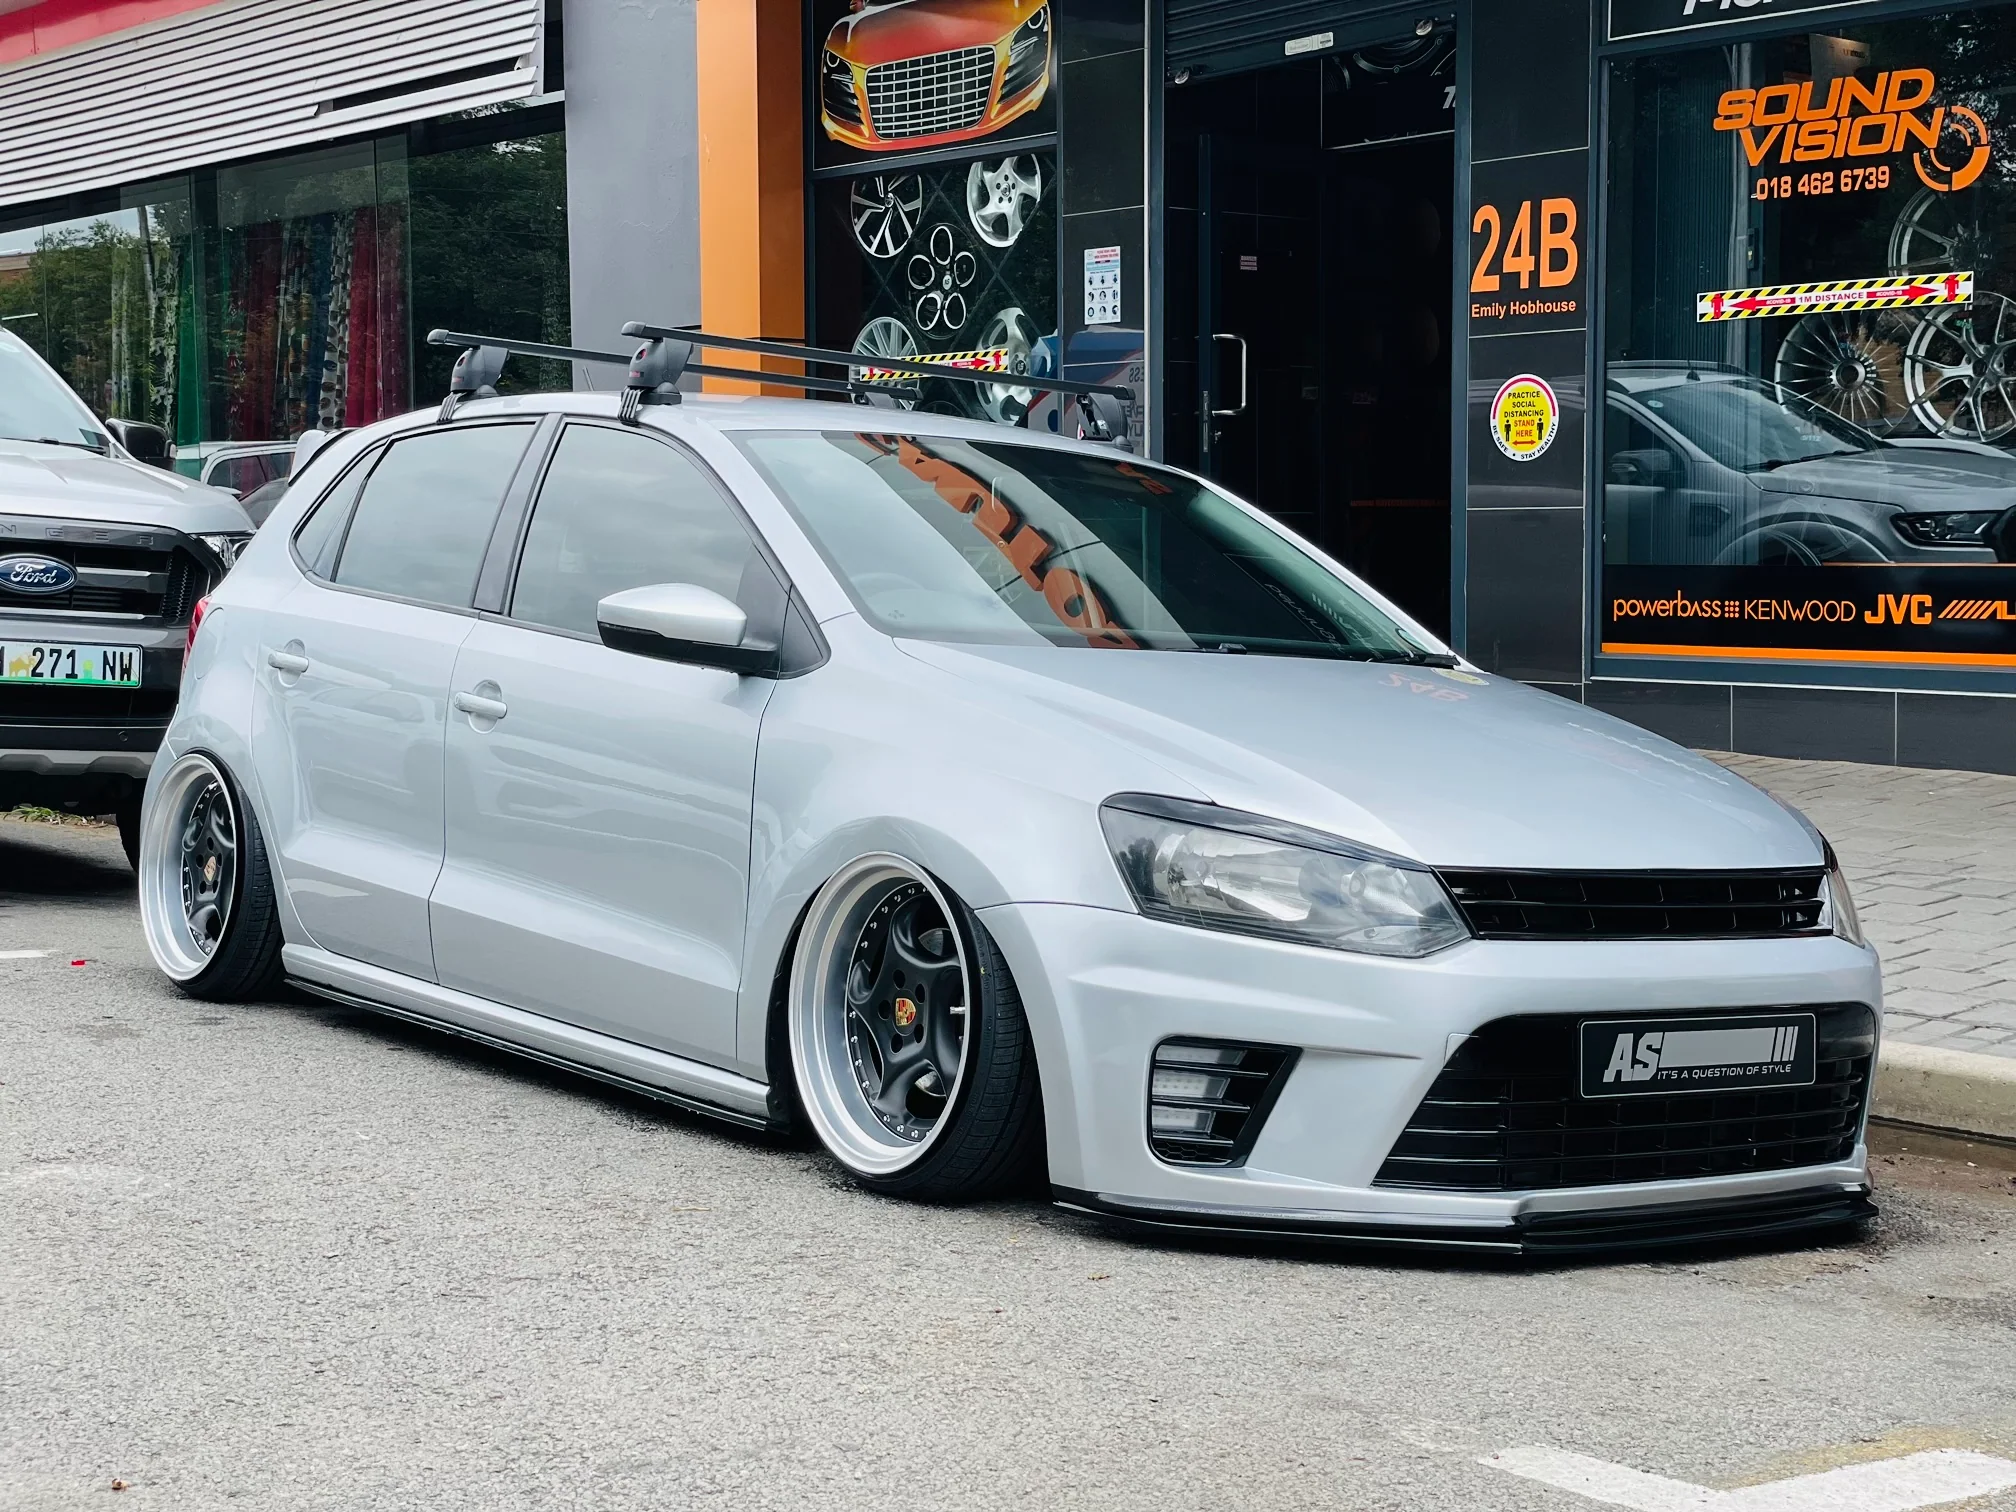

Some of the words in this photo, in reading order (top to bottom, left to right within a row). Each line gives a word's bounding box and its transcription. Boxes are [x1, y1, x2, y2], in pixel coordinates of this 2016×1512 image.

[1713, 68, 1935, 131] SOUND
[1739, 107, 1945, 167] VISION
[1756, 176, 1792, 200] 018
[1797, 171, 1834, 195] 462
[1840, 165, 1890, 192] 6739
[1470, 197, 1579, 293] 24B
[1471, 302, 1507, 320] Emily
[1510, 300, 1577, 315] Hobhouse
[1815, 292, 1865, 302] DISTANCE
[1508, 391, 1540, 399] PRACTICE
[1504, 410, 1544, 418] DISTANCING
[1514, 419, 1535, 427] STAND
[1492, 425, 1499, 434] BE
[1496, 436, 1508, 453] SAFE
[1515, 429, 1533, 437] HERE
[1520, 451, 1536, 460] STAY
[1537, 422, 1556, 454] HEALTHY
[10, 562, 57, 584] Ford
[1613, 590, 1722, 622] powerbass
[1744, 600, 1856, 622] KENWOOD
[1864, 593, 1933, 625] JVC
[31, 647, 78, 679] 271
[102, 650, 133, 682] NW
[1602, 1032, 1664, 1083] AS
[1657, 1069, 1678, 1080] IT'S
[1681, 1071, 1689, 1079] A
[1692, 1066, 1745, 1079] QUESTION
[1746, 1065, 1760, 1075] OF
[1762, 1064, 1792, 1074] STYLE
